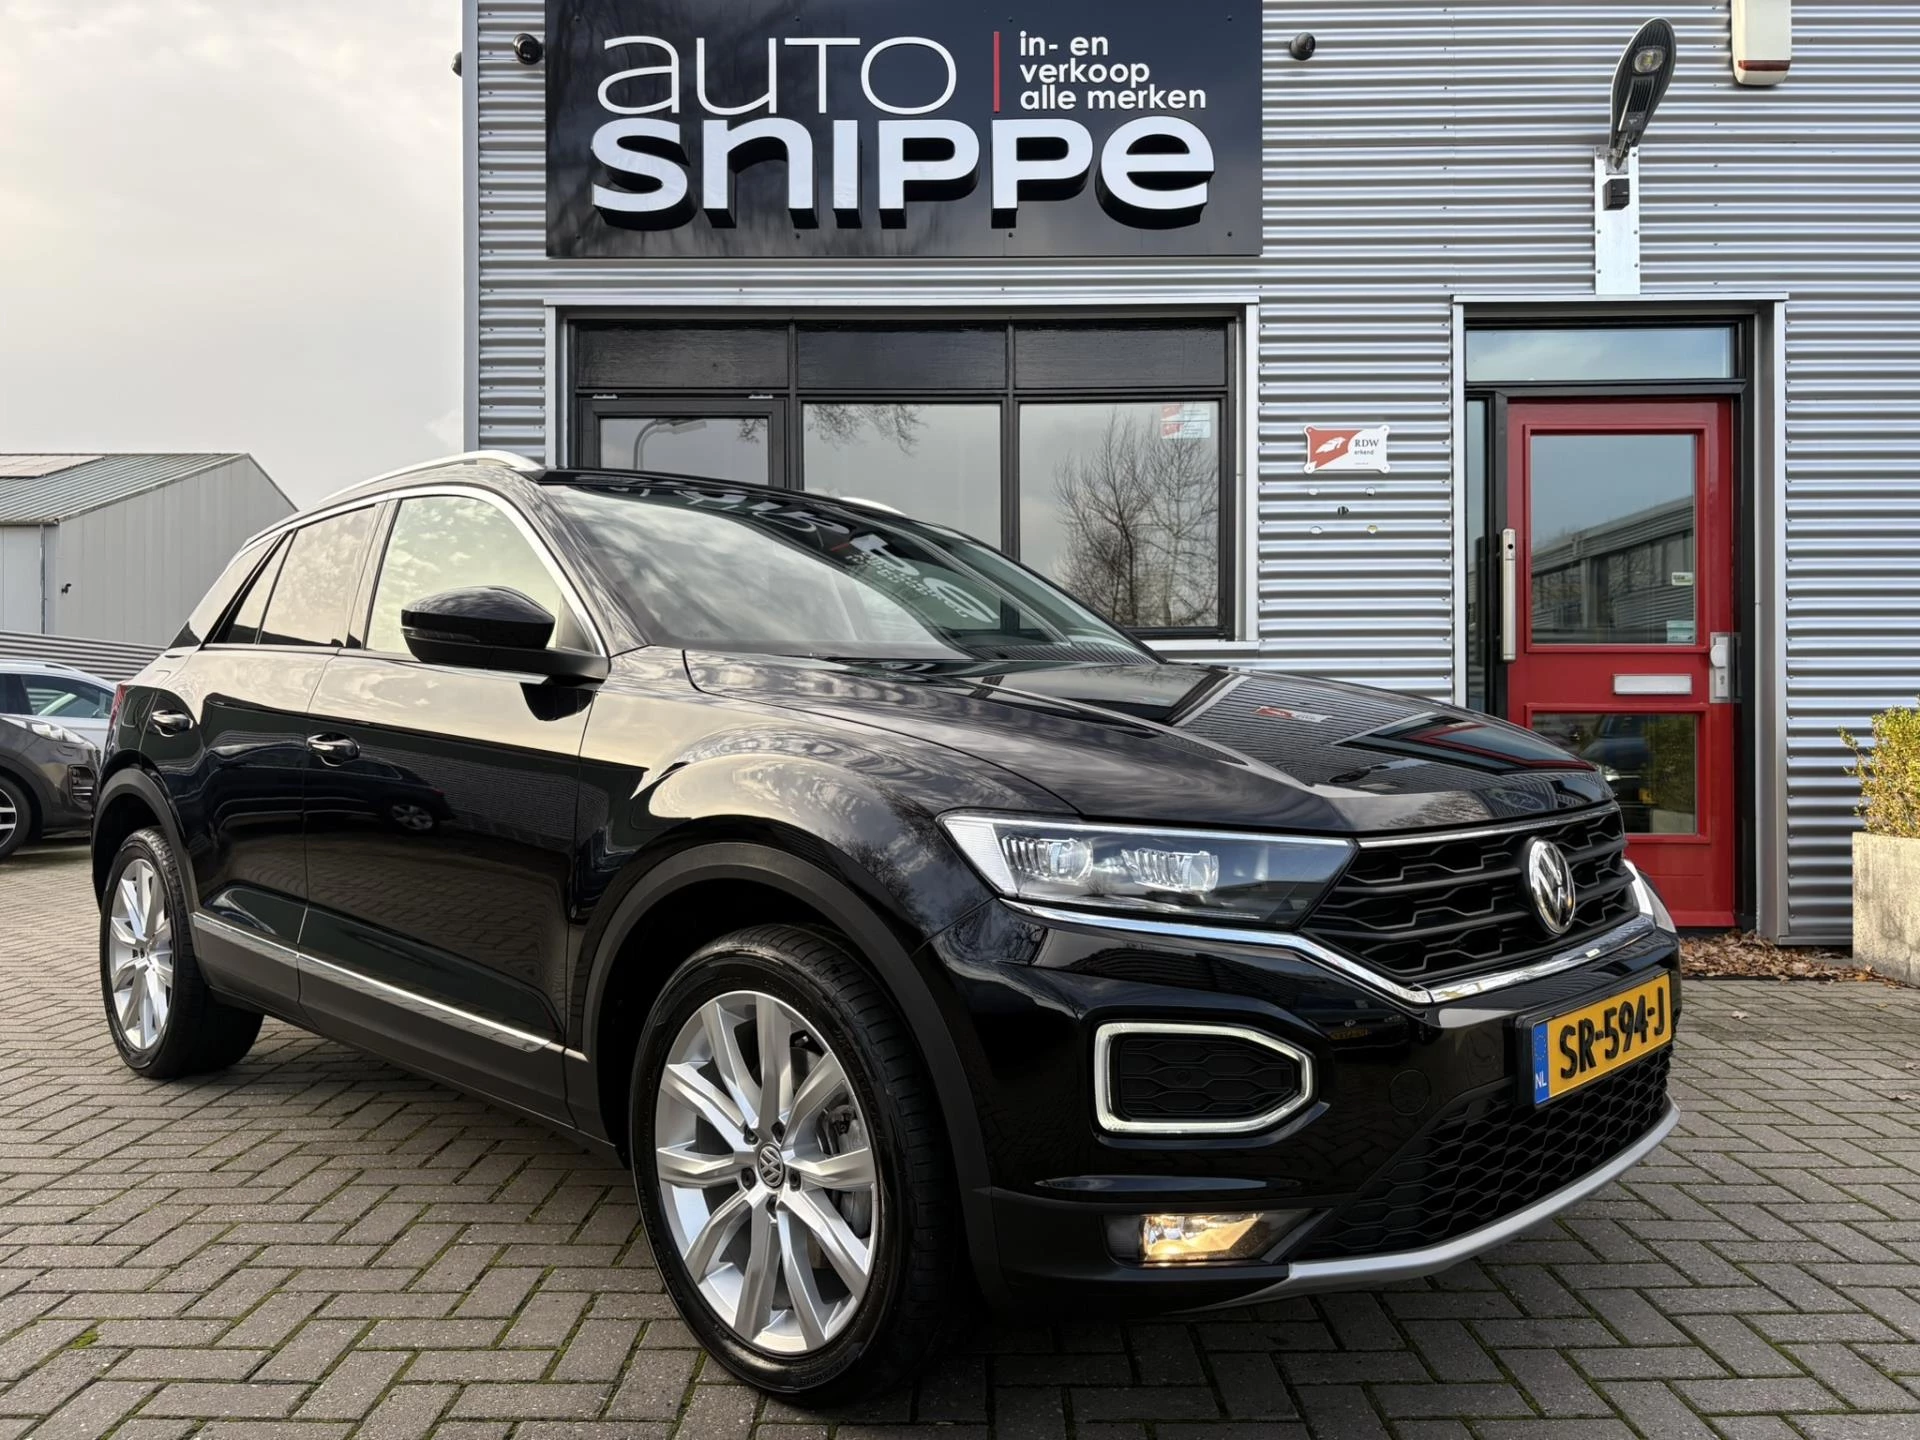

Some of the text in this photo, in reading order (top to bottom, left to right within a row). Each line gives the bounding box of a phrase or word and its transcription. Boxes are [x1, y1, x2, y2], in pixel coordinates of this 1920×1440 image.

[1019, 30, 1109, 56] in- en
[1019, 57, 1150, 89] verkoop
[1020, 83, 1206, 110] alle merken
[1354, 438, 1379, 448] RDW
[1559, 986, 1665, 1080] SR-594-J
[1534, 1071, 1548, 1090] NL
